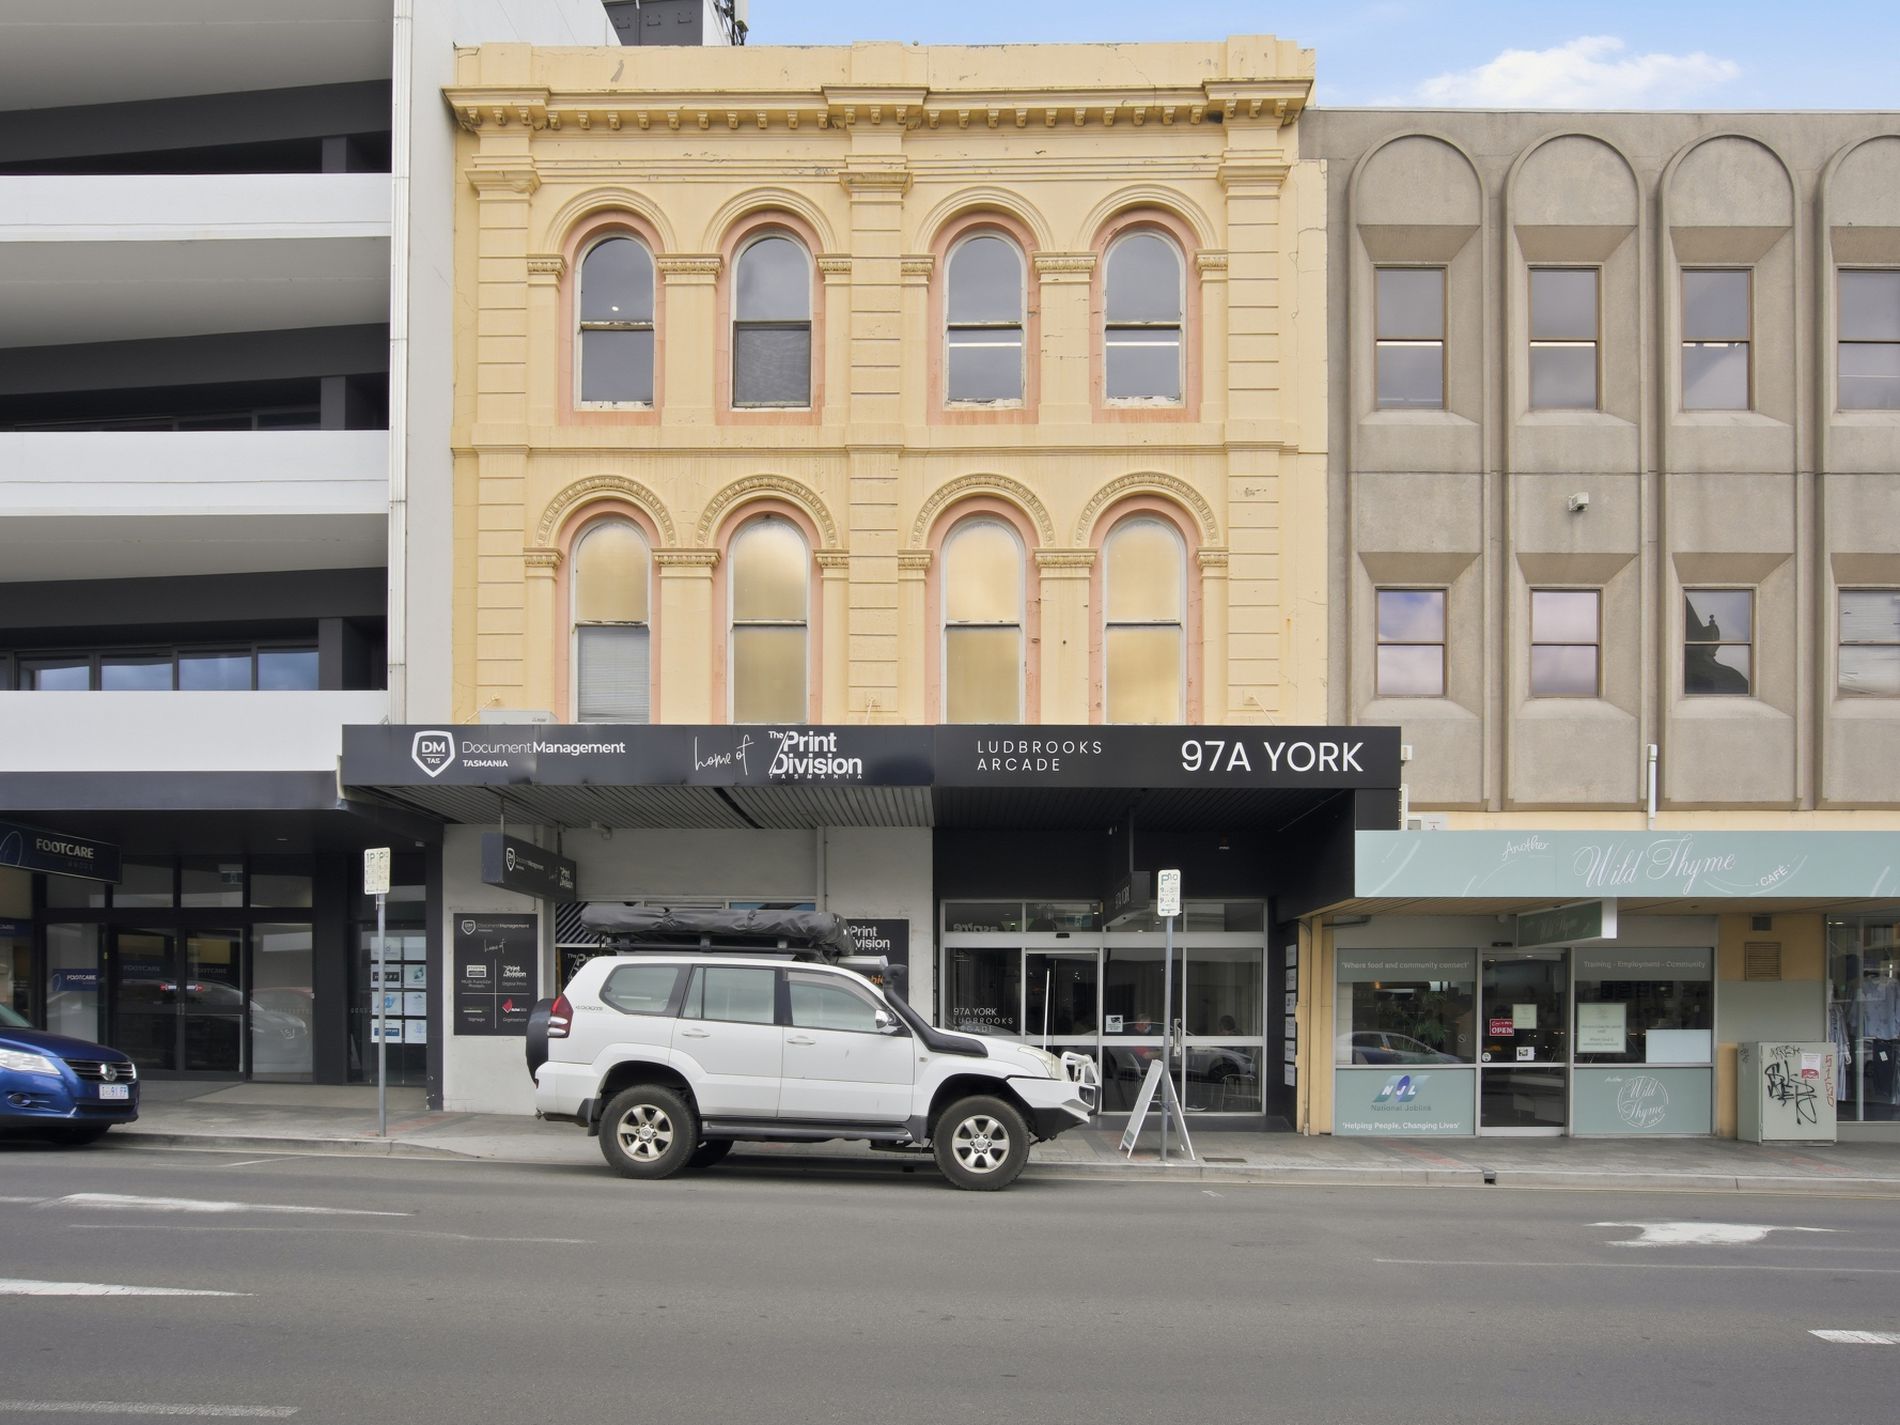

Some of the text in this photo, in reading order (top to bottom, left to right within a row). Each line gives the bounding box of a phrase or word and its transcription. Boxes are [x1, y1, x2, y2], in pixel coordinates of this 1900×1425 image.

[768, 730, 784, 739] The
[783, 730, 837, 752] Print
[421, 742, 445, 753] DM
[977, 740, 1102, 755] LUDBROOKS
[694, 734, 755, 775] home of
[1181, 740, 1364, 772] 97A YORK
[426, 757, 441, 765] TAS
[462, 759, 508, 768] TASMANIA
[771, 752, 863, 775] Division
[977, 757, 1061, 772] ARCADE
[35, 838, 95, 859] FOOTCARE
[1502, 834, 1550, 861] Another
[1573, 832, 1736, 896] Wild Thyme
[850, 925, 878, 937] Print
[853, 936, 890, 948] vision
[1367, 961, 1384, 969] food
[1384, 961, 1399, 969] and
[1399, 961, 1438, 970] community
[953, 1007, 998, 1016] 97A YORK
[1370, 1104, 1402, 1112] National
[1402, 1122, 1438, 1131] Changing
